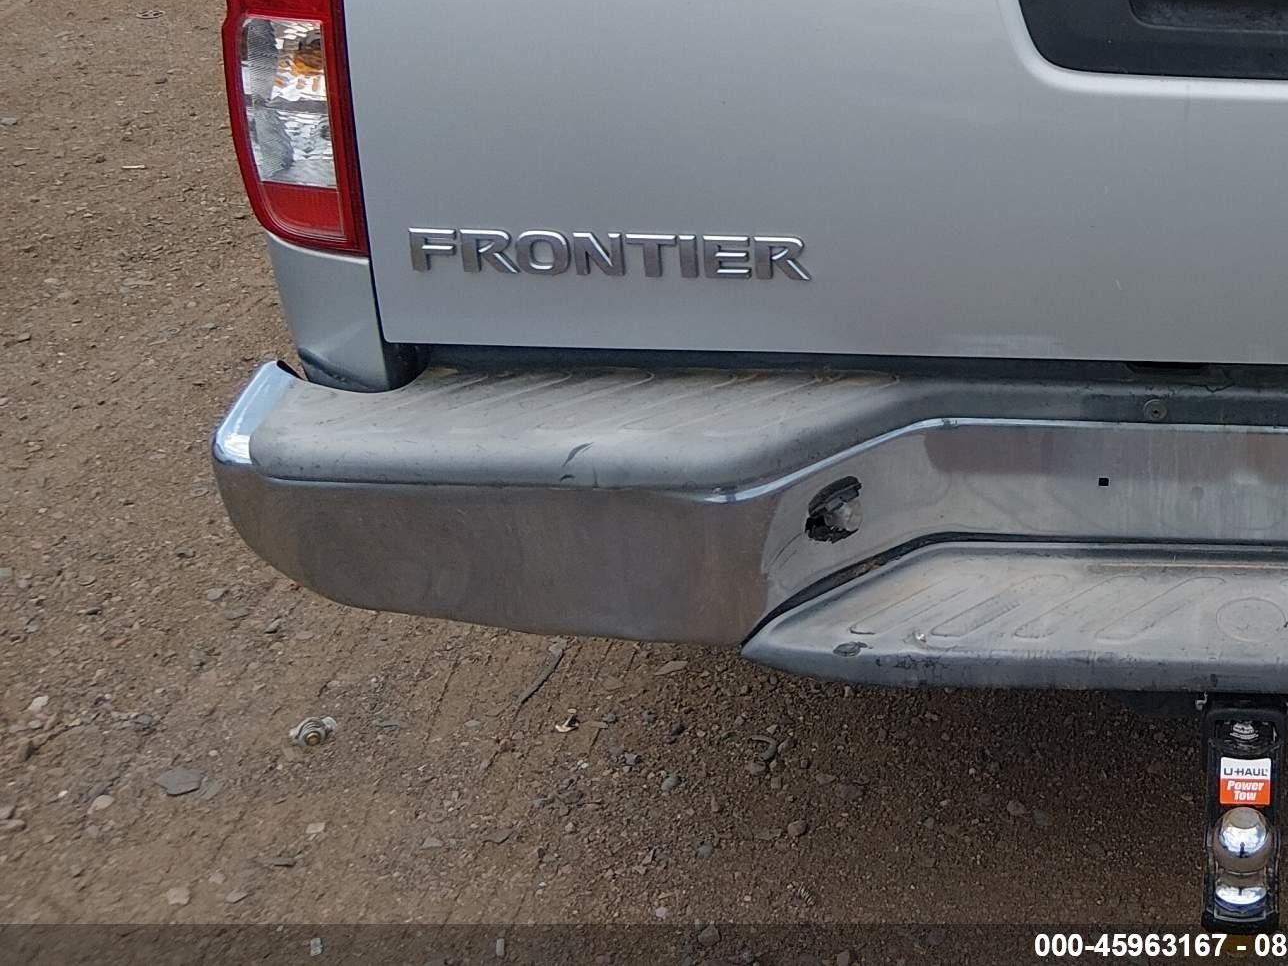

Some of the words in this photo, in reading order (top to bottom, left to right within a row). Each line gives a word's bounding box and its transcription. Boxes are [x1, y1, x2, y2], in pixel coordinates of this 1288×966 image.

[407, 226, 813, 282] FRONTIER
[1227, 779, 1264, 791] Power
[1233, 790, 1257, 801] Tow
